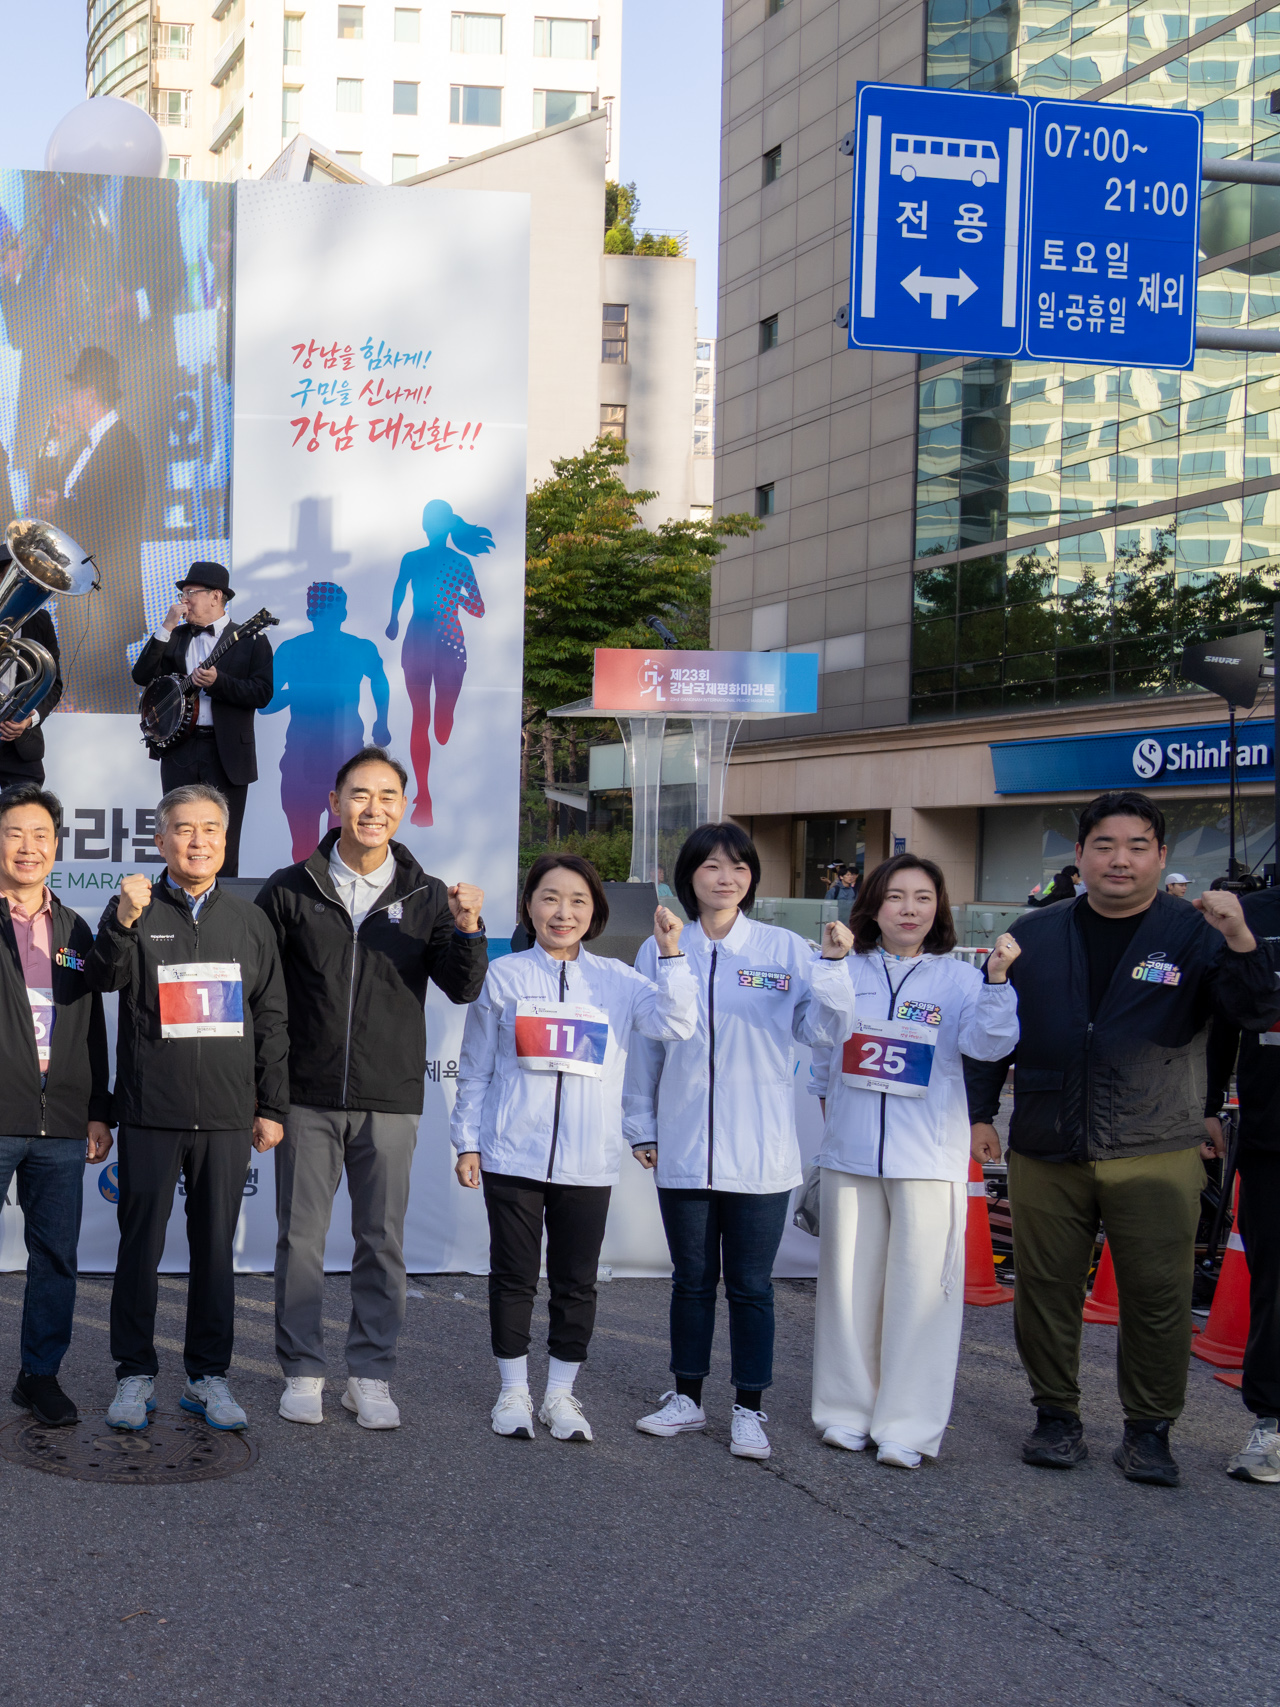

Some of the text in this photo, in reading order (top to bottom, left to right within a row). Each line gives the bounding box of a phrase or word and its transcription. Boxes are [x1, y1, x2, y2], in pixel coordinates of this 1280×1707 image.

[1044, 122, 1149, 164] 07:00~
[1104, 176, 1189, 218] 21:00
[1039, 238, 1130, 281] 토요일
[1136, 271, 1186, 316] 제외
[290, 336, 433, 372] 강남을 힘차게!
[290, 377, 433, 409] 구민을 신나게!
[290, 410, 483, 452] 강남 대전환!!
[670, 668, 710, 681] 제23회
[1203, 655, 1242, 666] SHURE
[670, 683, 776, 696] 강남국제평화마라톤
[1131, 966, 1181, 986] 이종원
[1146, 960, 1173, 971] 구의원
[739, 975, 789, 991] 오온누리
[196, 988, 210, 1016] 1
[910, 1000, 935, 1012] 구의원
[545, 1024, 575, 1053] 11
[858, 1041, 908, 1075] 25
